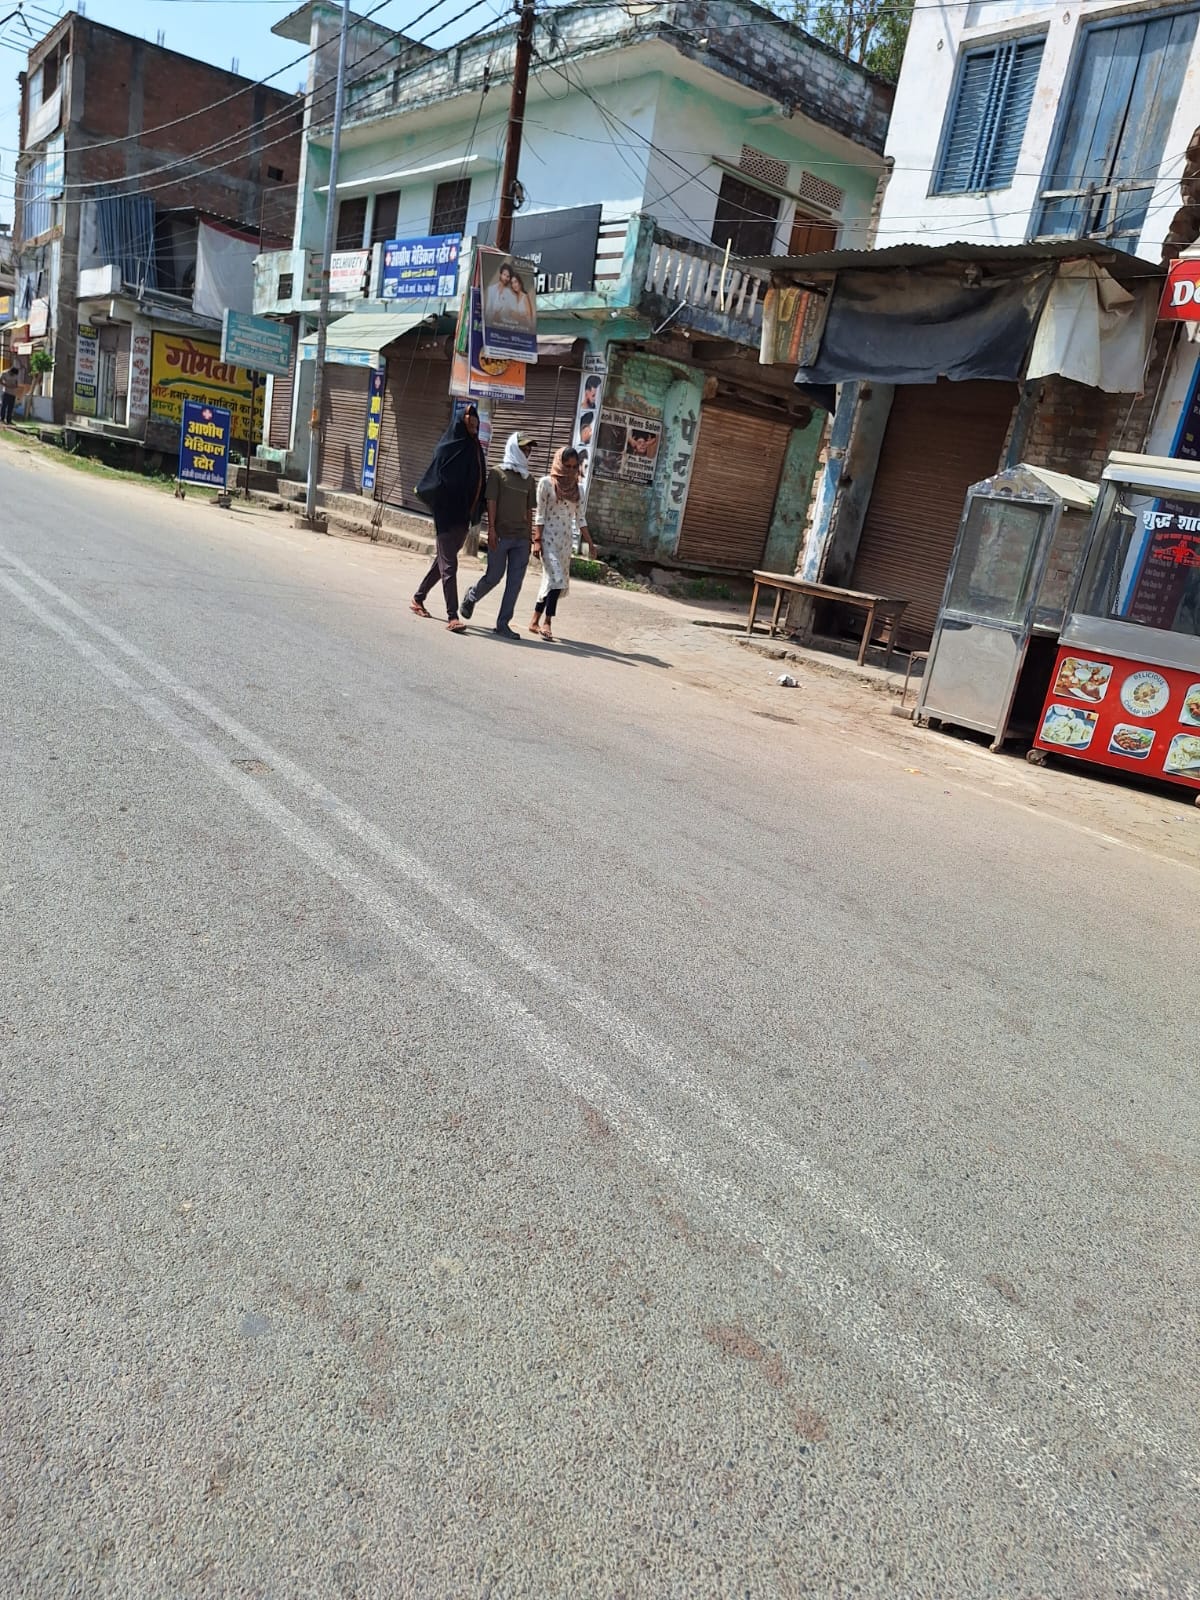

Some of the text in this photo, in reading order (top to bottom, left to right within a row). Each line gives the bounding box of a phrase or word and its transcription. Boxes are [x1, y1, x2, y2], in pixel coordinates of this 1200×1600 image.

[412, 244, 436, 266] मेडिकल
[534, 272, 573, 293] ALON
[188, 421, 224, 440] आशीष
[184, 434, 226, 456] मेडिकल
[193, 454, 215, 471] स्टोर
[1143, 510, 1174, 530] शुद्ध
[1133, 672, 1164, 686] DELICIOUS
[1141, 708, 1159, 716] WALA
